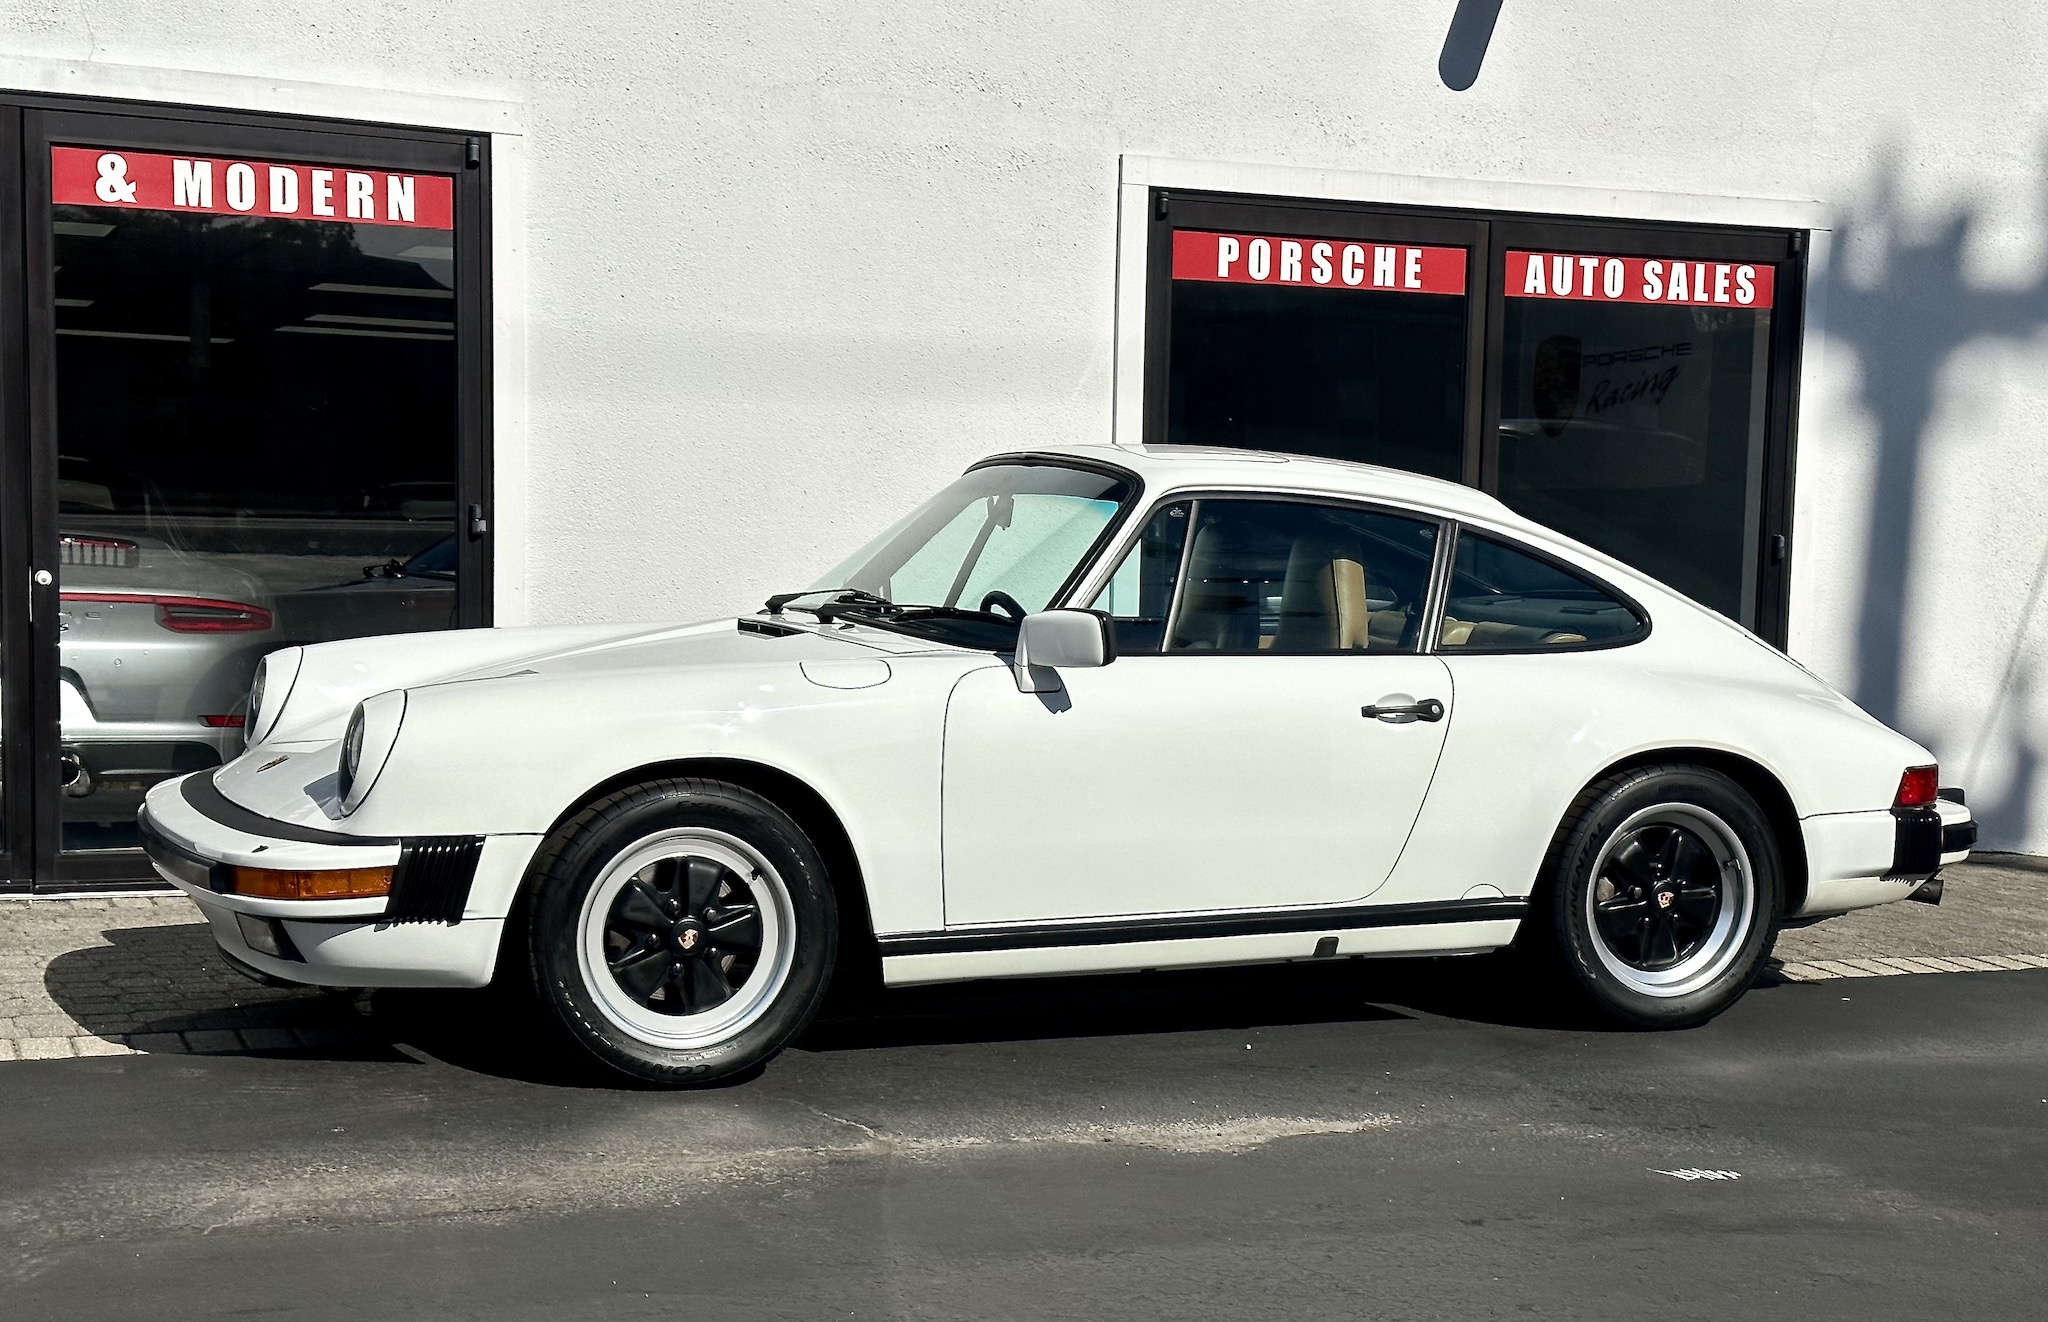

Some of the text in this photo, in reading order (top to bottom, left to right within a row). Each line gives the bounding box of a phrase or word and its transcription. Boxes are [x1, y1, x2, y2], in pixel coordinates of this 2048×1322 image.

[95, 153, 416, 223] & MODERN
[1217, 236, 1422, 289] PORSCHE
[1523, 254, 1756, 305] AUTO SALES
[1582, 342, 1692, 368] PORSCHE
[1585, 364, 1680, 416] Racing
